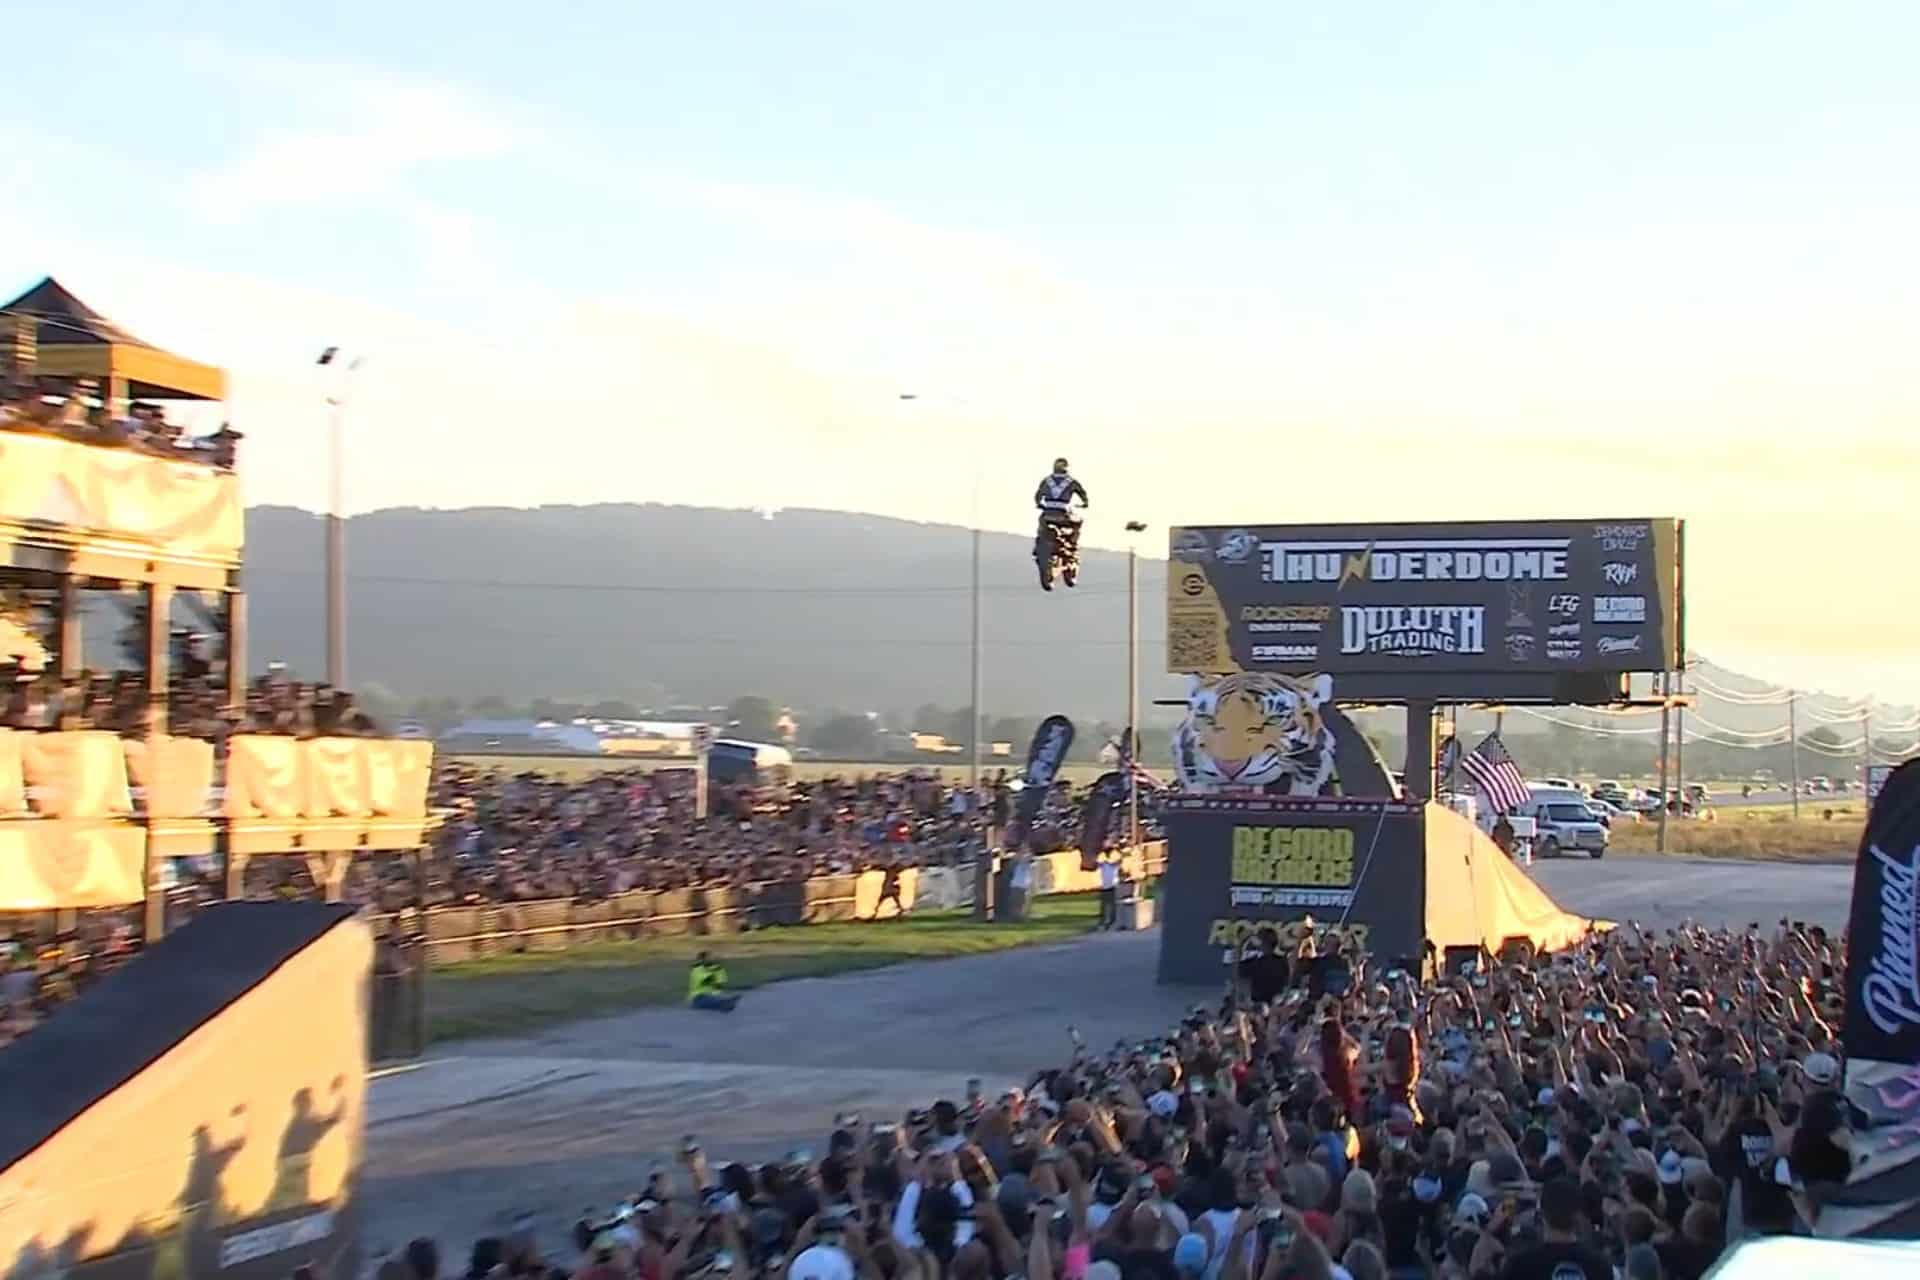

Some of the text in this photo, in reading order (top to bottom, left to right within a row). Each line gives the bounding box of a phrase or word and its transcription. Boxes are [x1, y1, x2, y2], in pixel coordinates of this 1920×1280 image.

[1258, 538, 1571, 585] THUNDERDOME
[1340, 606, 1486, 653] DULUTH
[1367, 631, 1455, 653] TRADING
[1863, 844, 1920, 1035] Pinned
